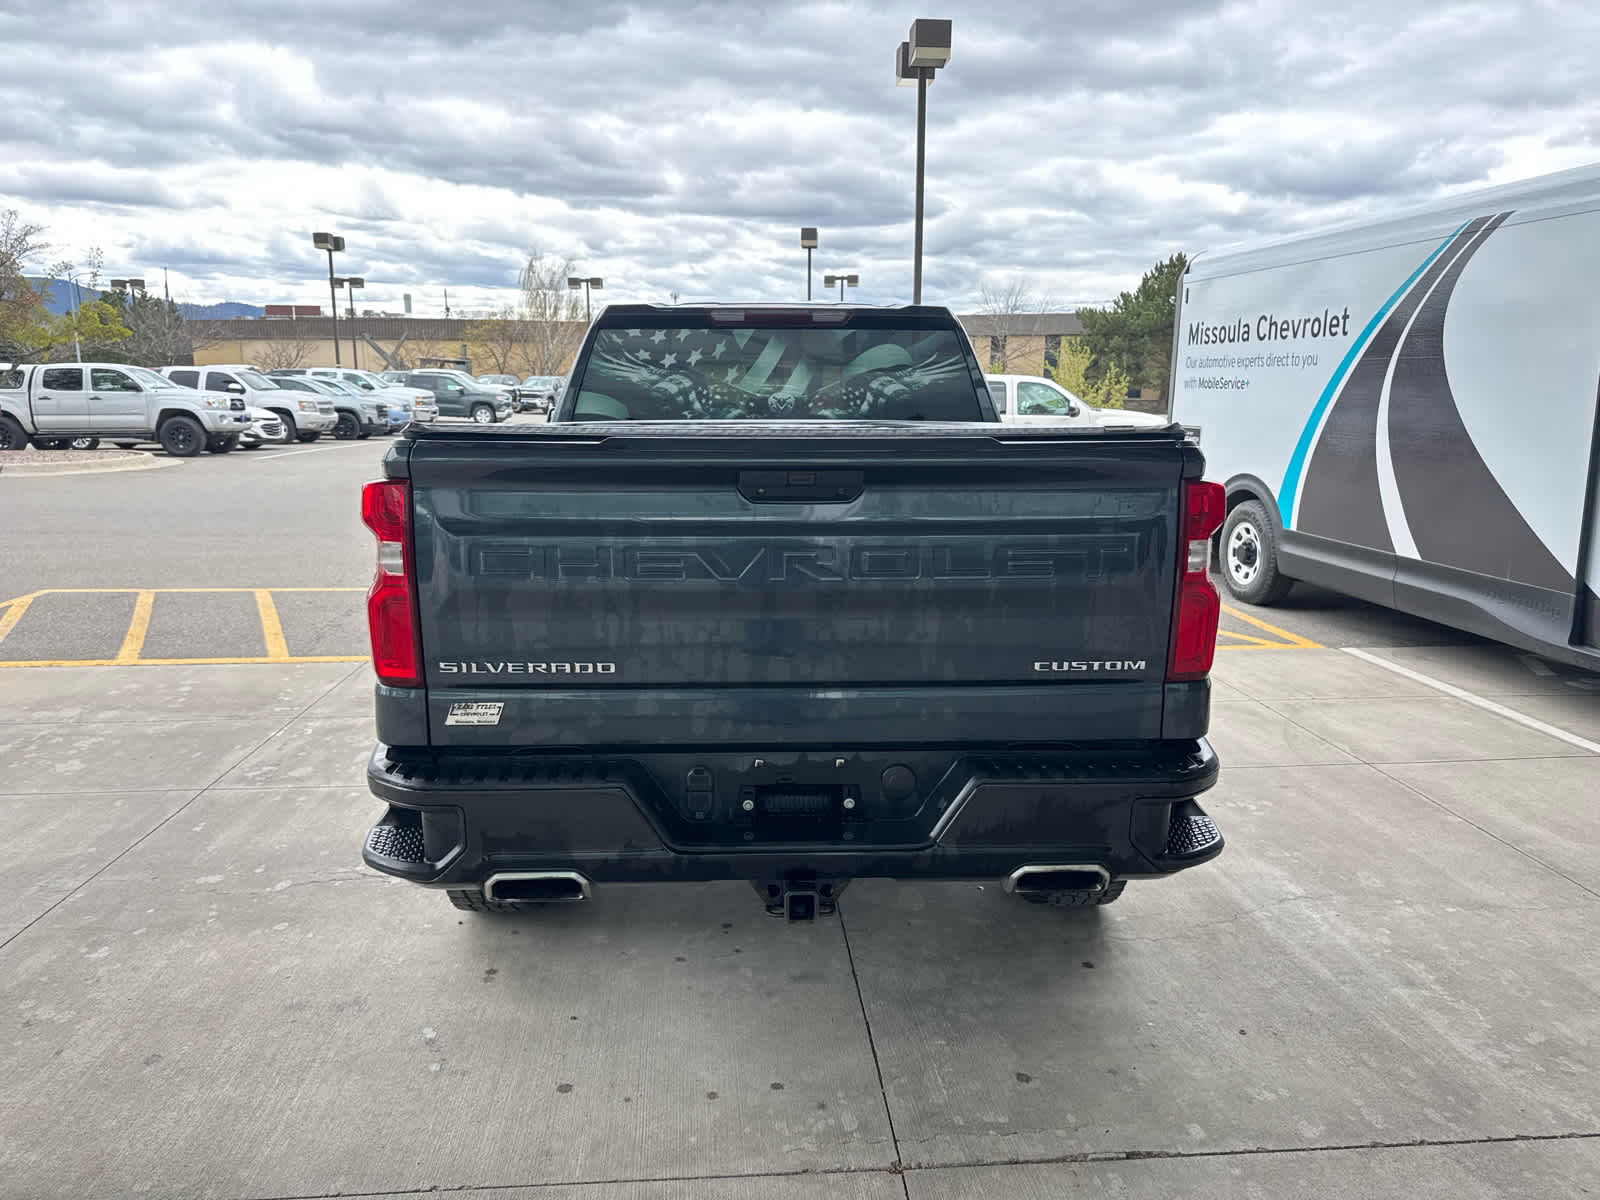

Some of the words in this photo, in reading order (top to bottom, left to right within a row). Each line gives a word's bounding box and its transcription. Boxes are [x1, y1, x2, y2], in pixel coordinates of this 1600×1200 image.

[1188, 318, 1250, 346] Missoula
[1256, 307, 1350, 342] Chevrolet
[1185, 356, 1198, 369] Our
[1199, 354, 1236, 369] automotive
[1237, 354, 1265, 371] experts
[1266, 353, 1290, 367] direct
[1291, 353, 1301, 367] to
[1301, 354, 1318, 370] you
[1184, 378, 1198, 391] with
[468, 536, 1141, 582] CHEVROLET
[439, 662, 616, 674] SILVERADO
[1034, 660, 1146, 671] CUSTOM
